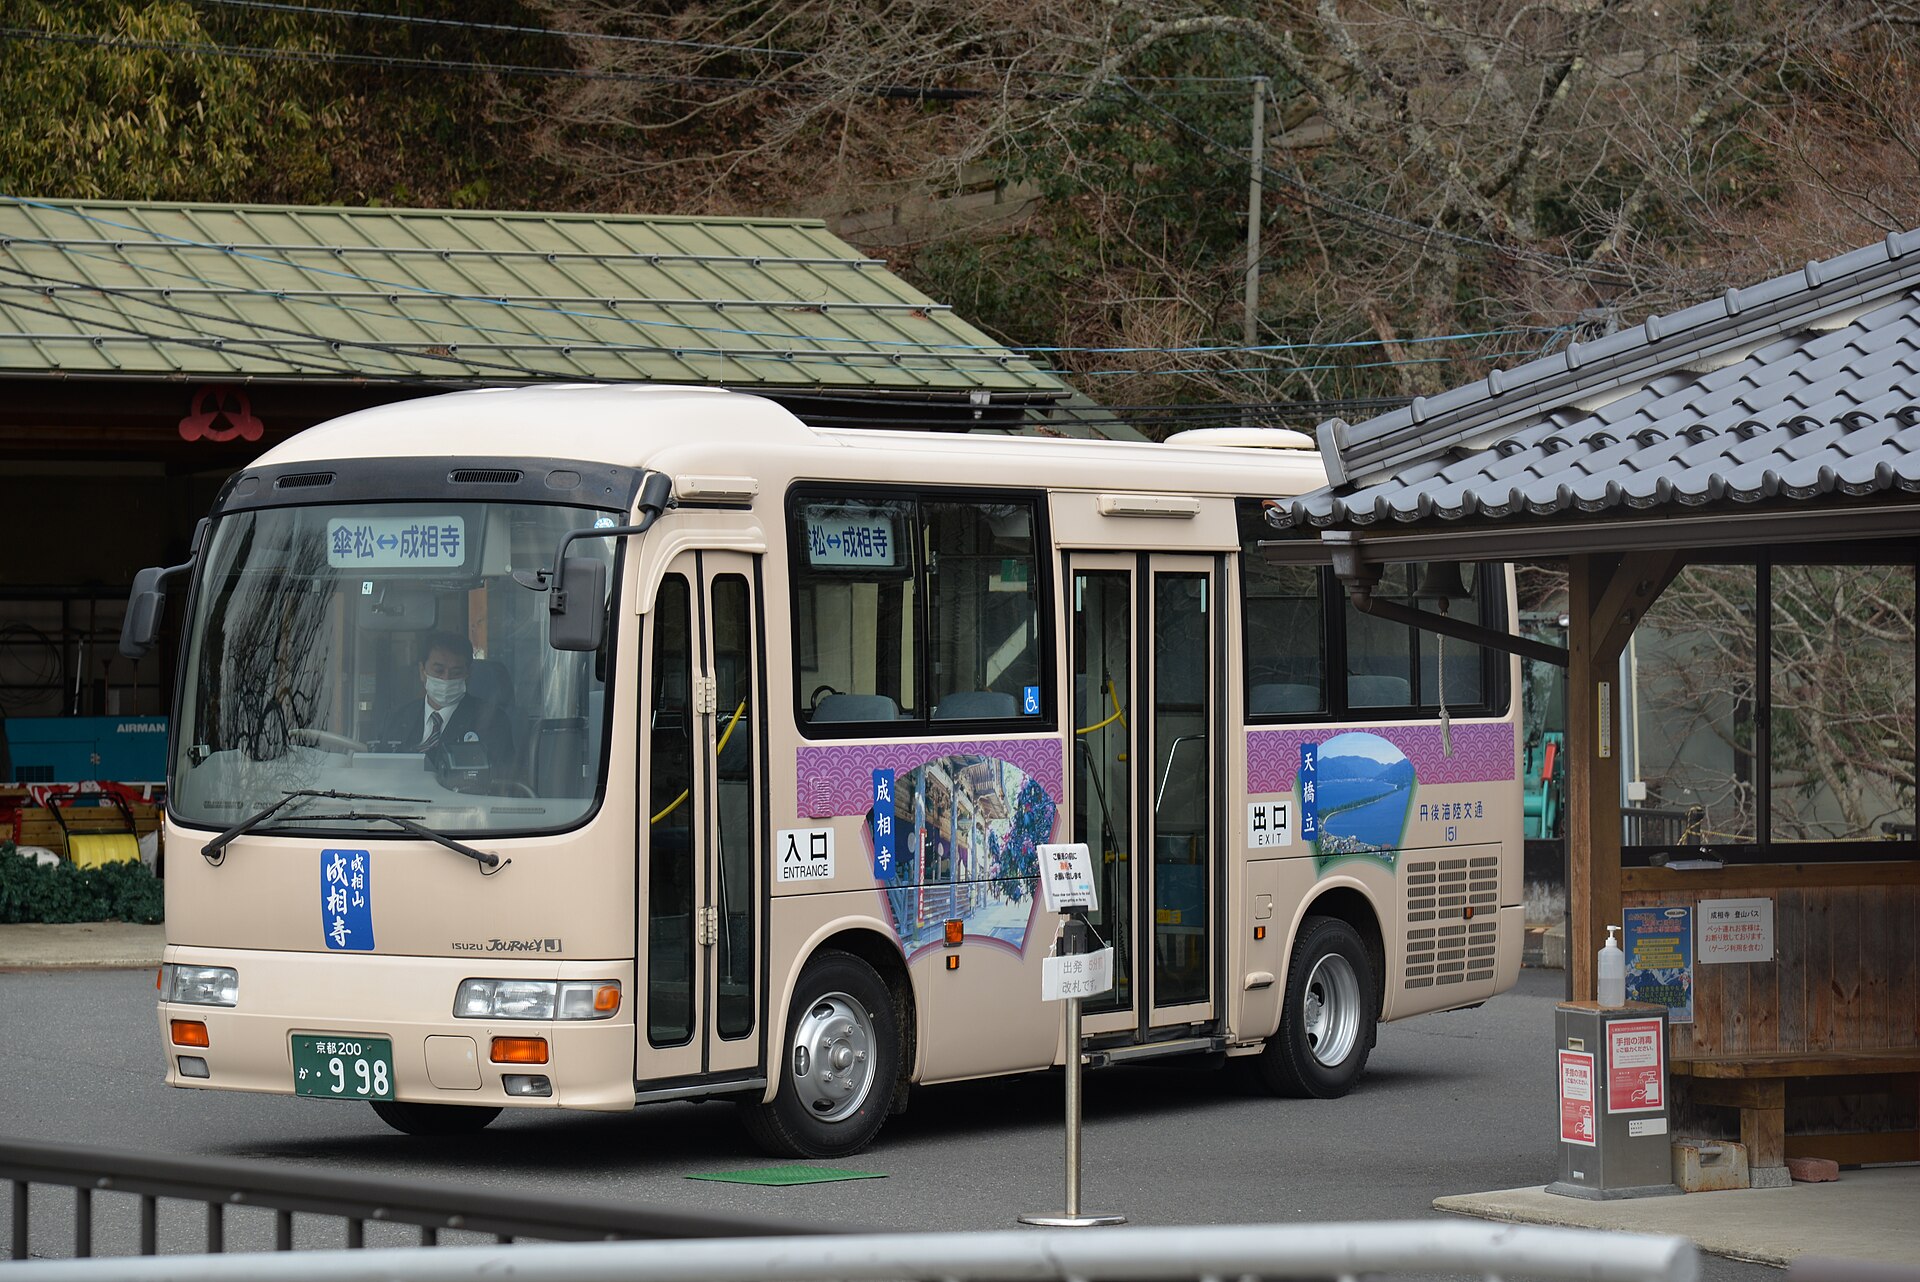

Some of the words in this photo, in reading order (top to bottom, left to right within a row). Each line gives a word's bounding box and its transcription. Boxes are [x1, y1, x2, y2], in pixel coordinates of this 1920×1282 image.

[333, 525, 374, 558] 傘松
[400, 525, 459, 558] 成相寺
[809, 525, 826, 556] 松
[842, 526, 887, 557] 成相寺
[117, 723, 165, 733] AIRMAN
[1303, 753, 1315, 833] 天橋立
[1253, 804, 1287, 831] 出口
[1420, 801, 1483, 821] 丹後海陸交通
[876, 777, 891, 871] 成相寺
[1445, 826, 1457, 841] 151
[785, 832, 827, 862] 入口
[1258, 833, 1282, 845] EXIT
[351, 853, 364, 908] 成相山
[784, 864, 828, 878] ENTRANCE
[326, 853, 351, 947] 成相寺
[1735, 910, 1759, 918] 登山バス
[486, 939, 542, 952] JOURNEY
[1064, 960, 1082, 974] 出発
